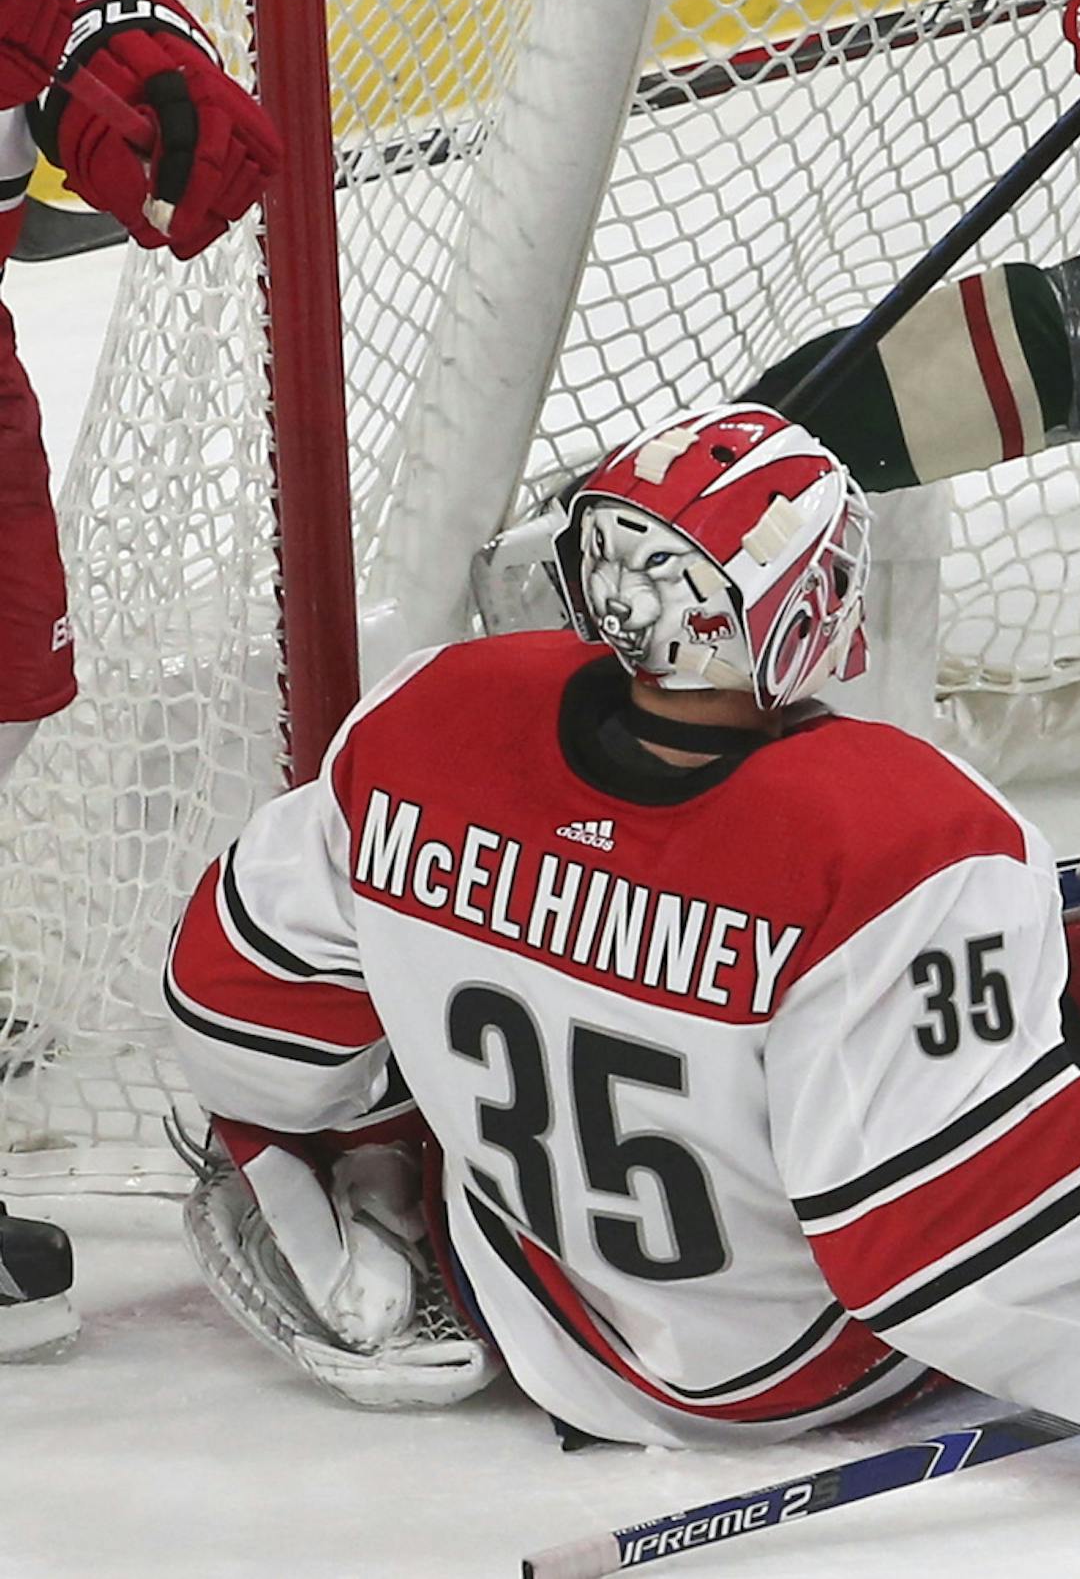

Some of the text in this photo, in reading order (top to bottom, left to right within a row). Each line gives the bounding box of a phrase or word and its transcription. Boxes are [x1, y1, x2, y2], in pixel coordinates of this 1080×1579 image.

[355, 788, 803, 1015] McELHINNEY
[556, 825, 614, 852] adidas
[910, 934, 1017, 1061] 35
[446, 979, 734, 1283] 35
